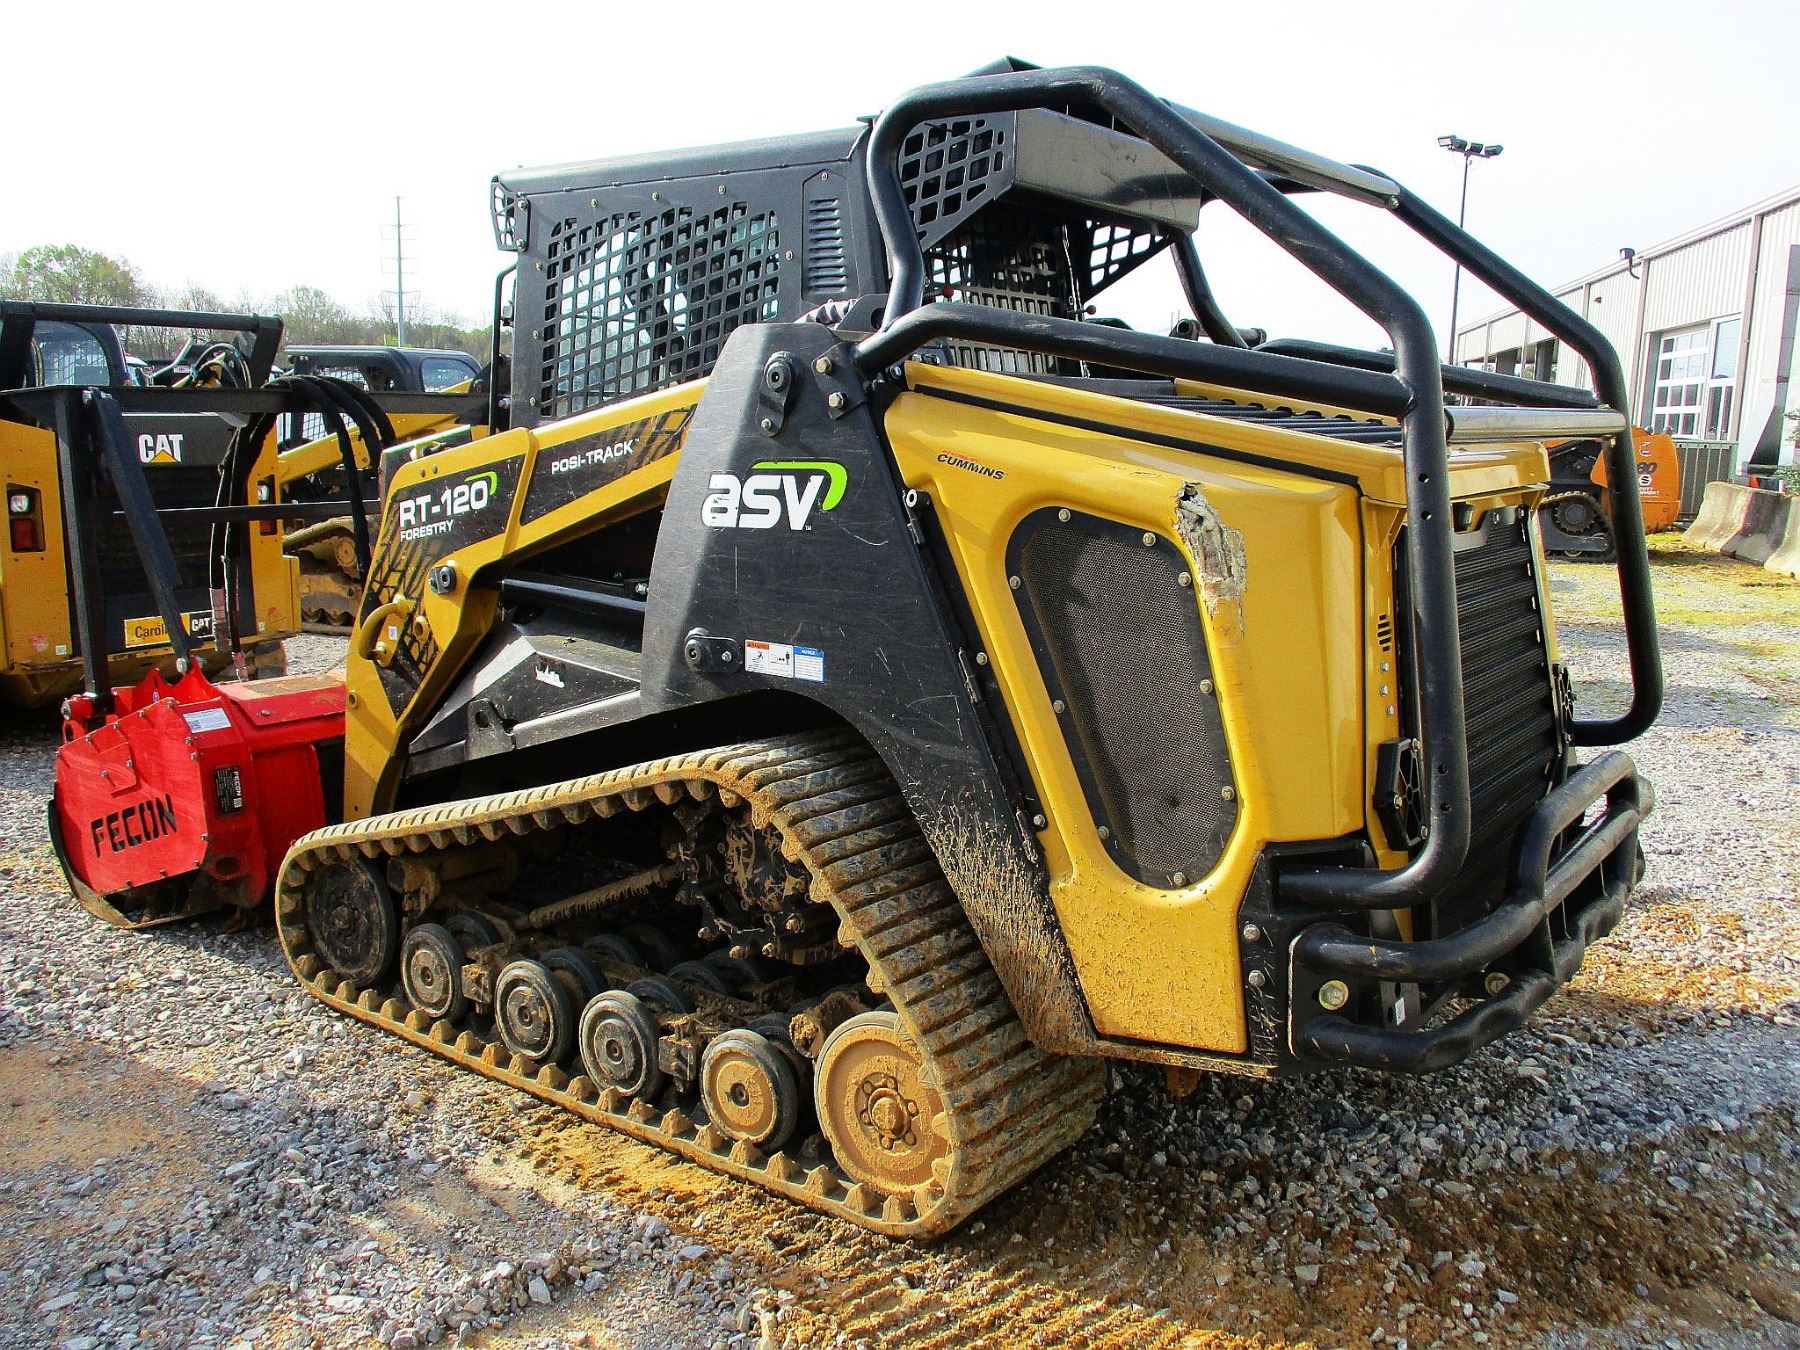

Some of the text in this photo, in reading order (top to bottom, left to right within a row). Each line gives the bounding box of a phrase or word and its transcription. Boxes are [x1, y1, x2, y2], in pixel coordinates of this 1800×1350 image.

[139, 434, 183, 463] CAT
[551, 439, 634, 475] POSI-TRACK
[937, 453, 1005, 480] CUMMINS
[399, 480, 488, 528] RT-120
[400, 520, 454, 542] FORESTRY
[135, 617, 211, 639] Carol CAT
[91, 793, 177, 858] FECON
